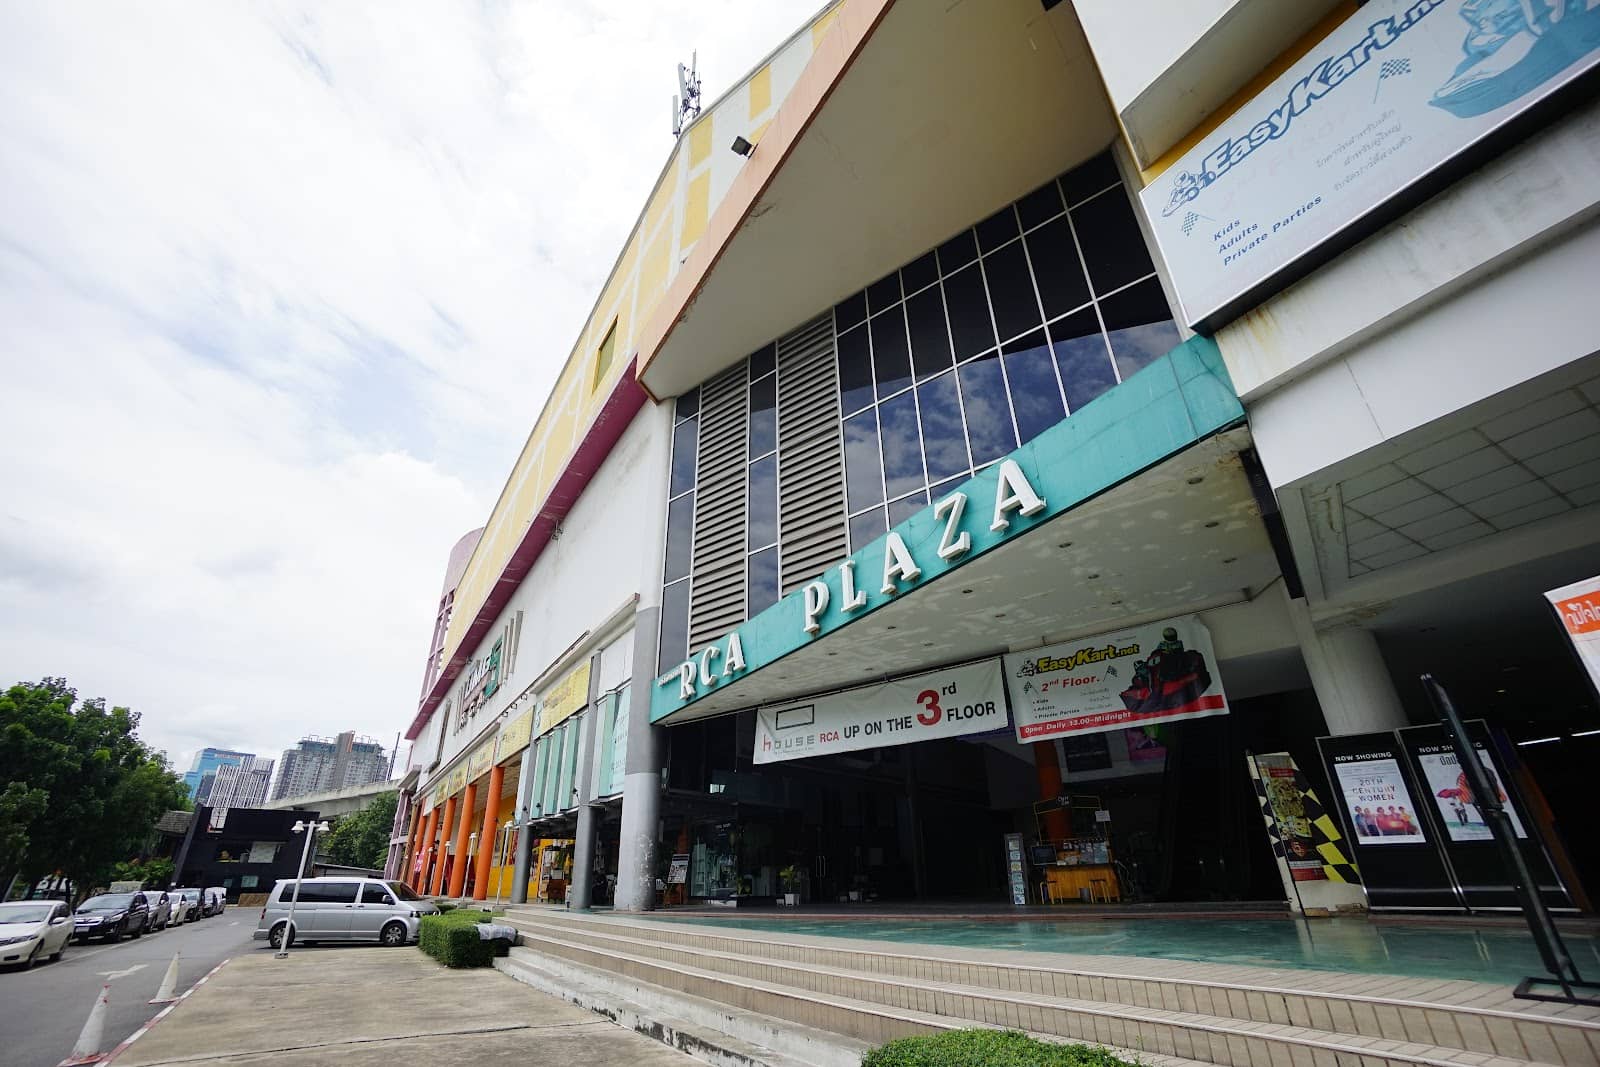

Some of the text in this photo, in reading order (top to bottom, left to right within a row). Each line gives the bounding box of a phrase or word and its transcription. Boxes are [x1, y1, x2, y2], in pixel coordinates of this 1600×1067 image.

[1201, 0, 1444, 180] EasyKart.n
[1213, 218, 1241, 241] Kids
[1219, 222, 1259, 253] Adults
[1223, 195, 1322, 266] Private Parties
[679, 458, 1048, 700] RCA PLAZA
[1041, 678, 1059, 692] 2nd
[819, 730, 840, 743] RCA
[843, 725, 860, 739] UP
[864, 720, 883, 735] ON
[886, 715, 913, 732] THE
[946, 701, 996, 722] FLOOR
[1025, 726, 1043, 735] Open
[1046, 721, 1066, 731] Daily
[1355, 751, 1393, 760] SHOWING
[1359, 778, 1384, 787] 20TH
[1358, 793, 1396, 802] WOMEN
